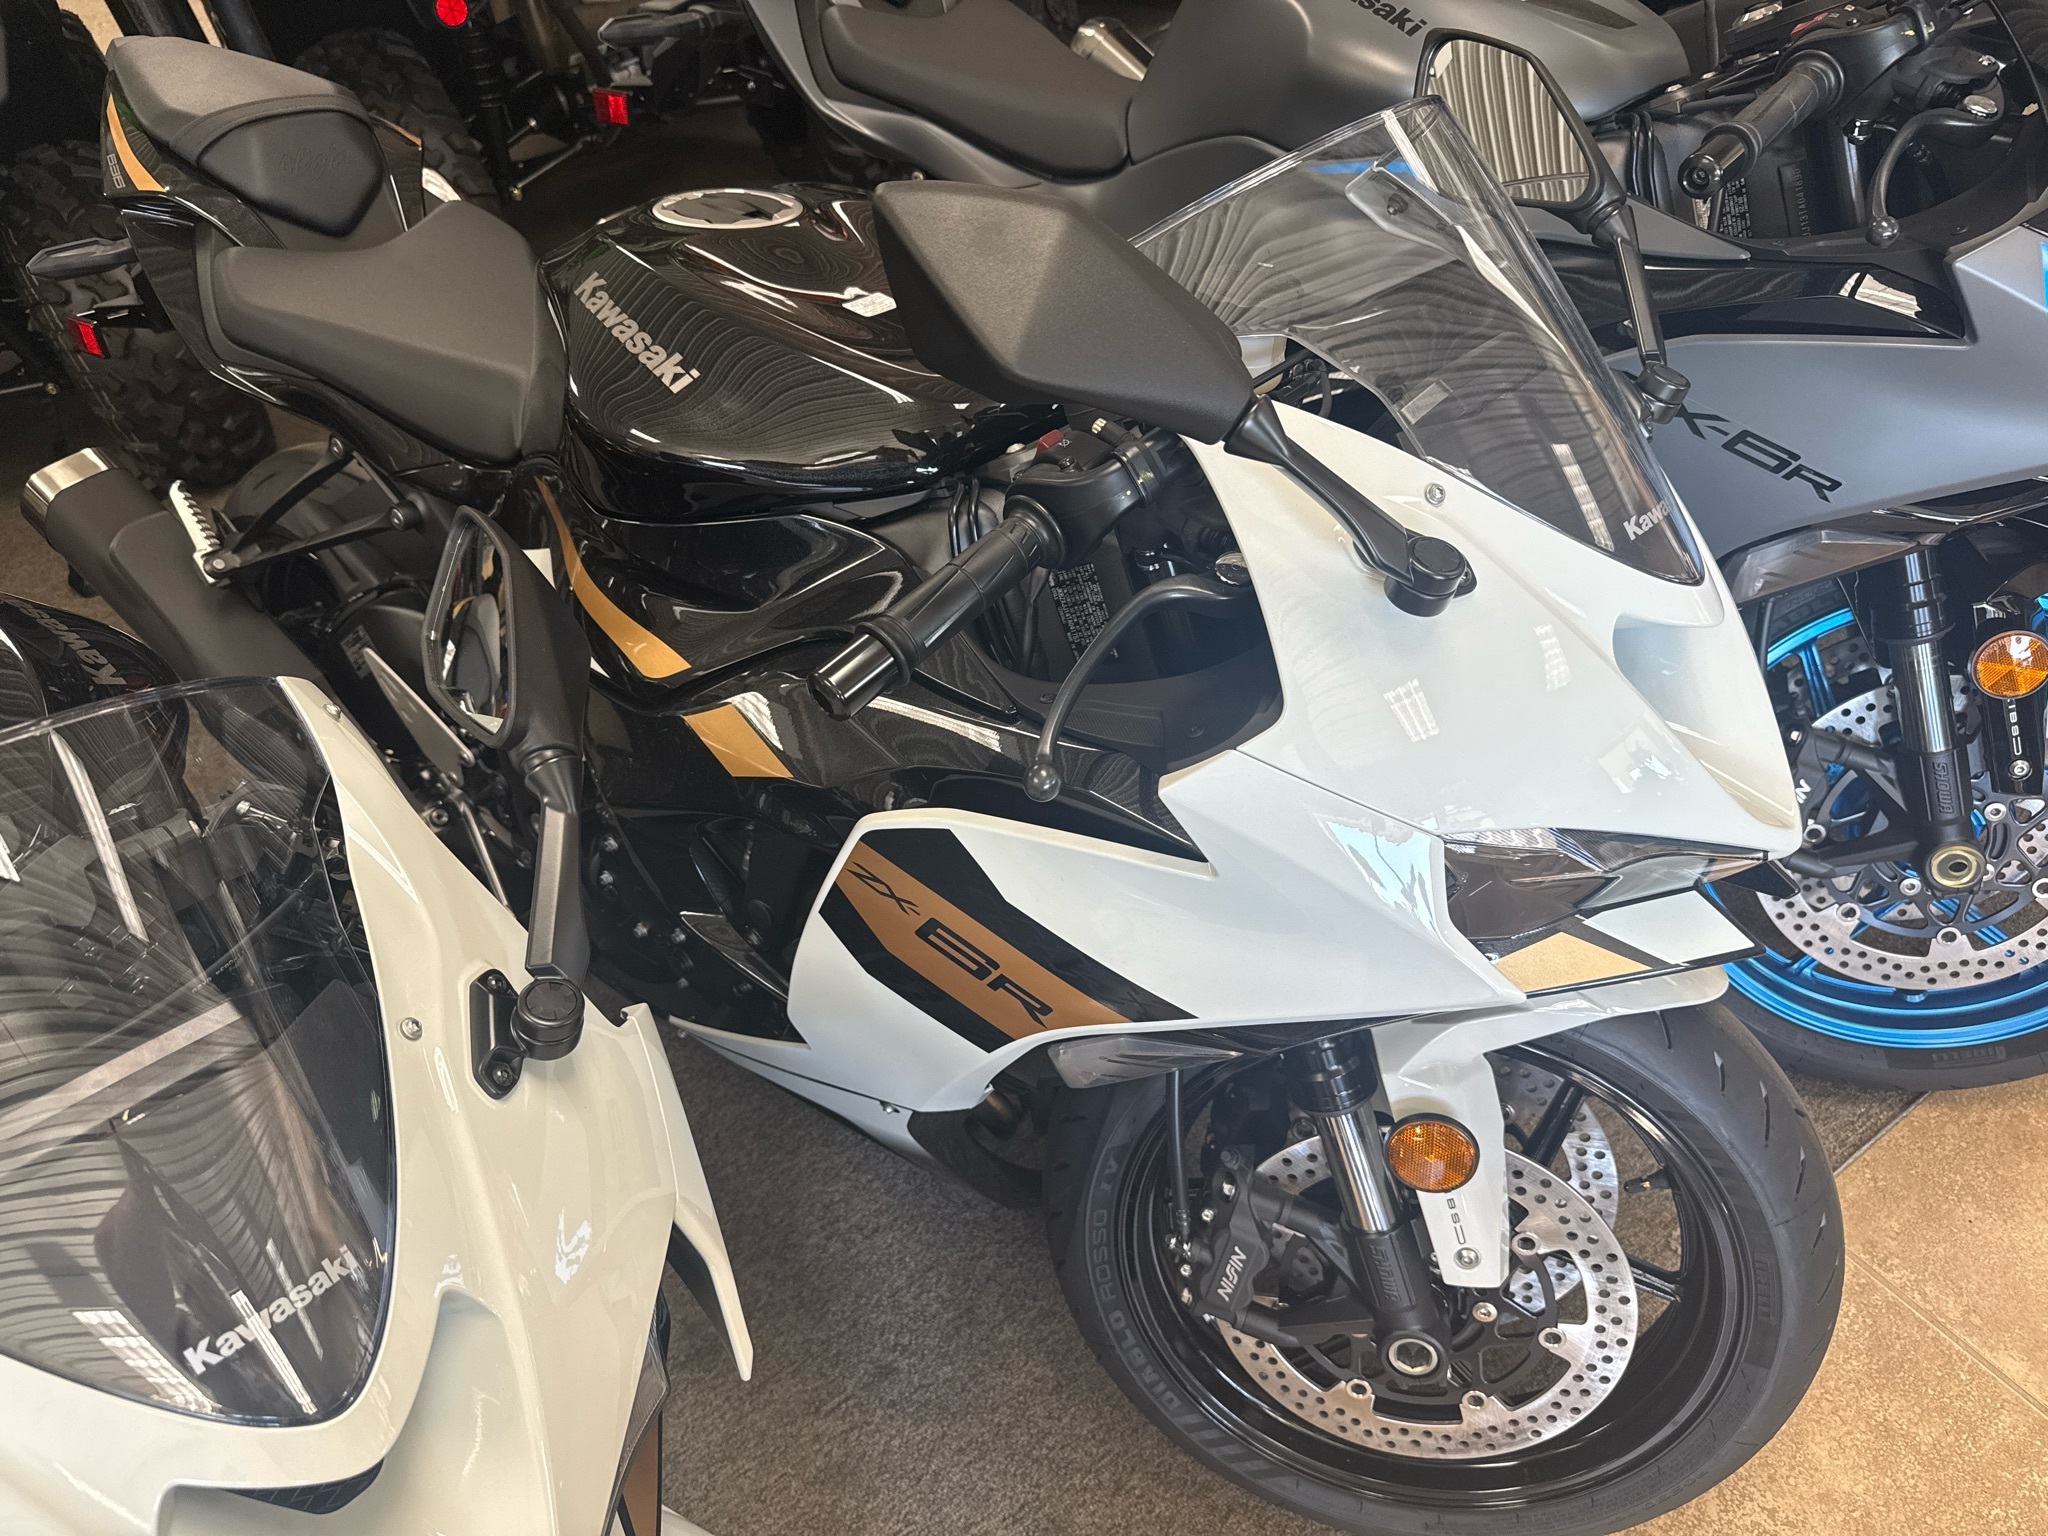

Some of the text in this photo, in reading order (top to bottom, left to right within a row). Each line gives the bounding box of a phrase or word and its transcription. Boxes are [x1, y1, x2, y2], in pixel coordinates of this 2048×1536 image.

[1350, 0, 1428, 37] saki
[106, 153, 126, 189] 636
[1793, 168, 1812, 236] JJ13TA041890
[574, 271, 700, 394] Kawasaki
[1675, 403, 1843, 504] X-6R
[1623, 500, 1670, 541] Kawa
[1933, 761, 1954, 815] SHOWA
[845, 861, 1054, 1029] ZX-6R
[1093, 1209, 1117, 1301] ROSSO
[183, 1243, 361, 1376] Kawasaki
